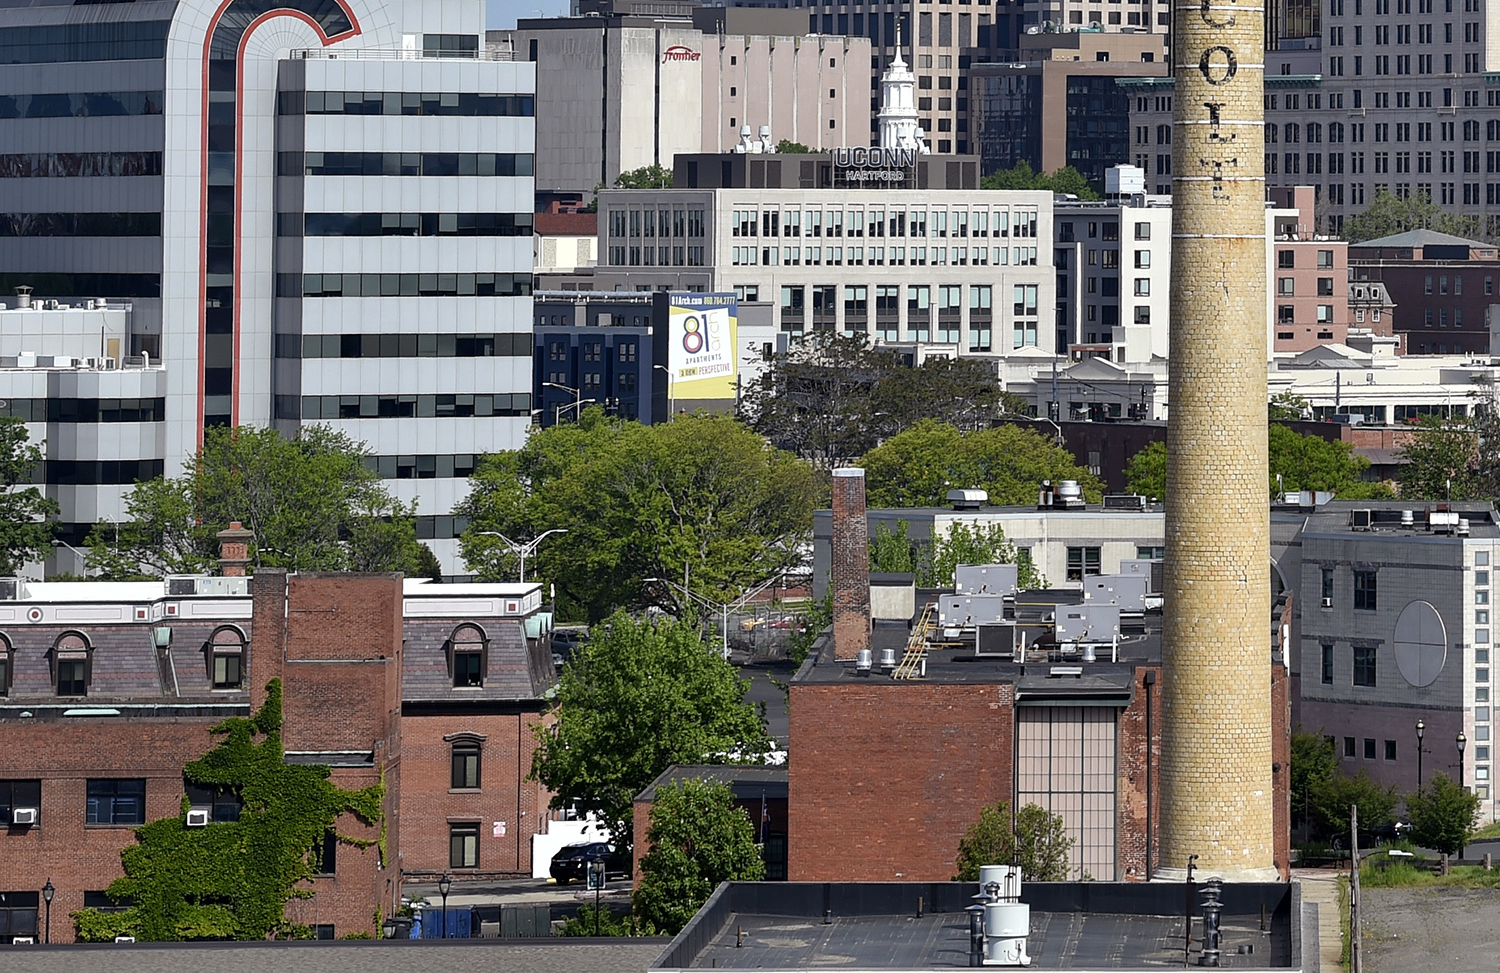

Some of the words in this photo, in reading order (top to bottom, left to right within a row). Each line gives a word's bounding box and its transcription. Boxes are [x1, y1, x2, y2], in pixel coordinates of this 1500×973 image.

[662, 46, 701, 64] frontier
[836, 146, 915, 167] UCONN
[846, 170, 904, 181] HARTFORD
[682, 314, 710, 354] 81
[709, 311, 721, 351] arch
[685, 353, 722, 365] APARTMENTS
[698, 362, 731, 376] PERSPECTIVE
